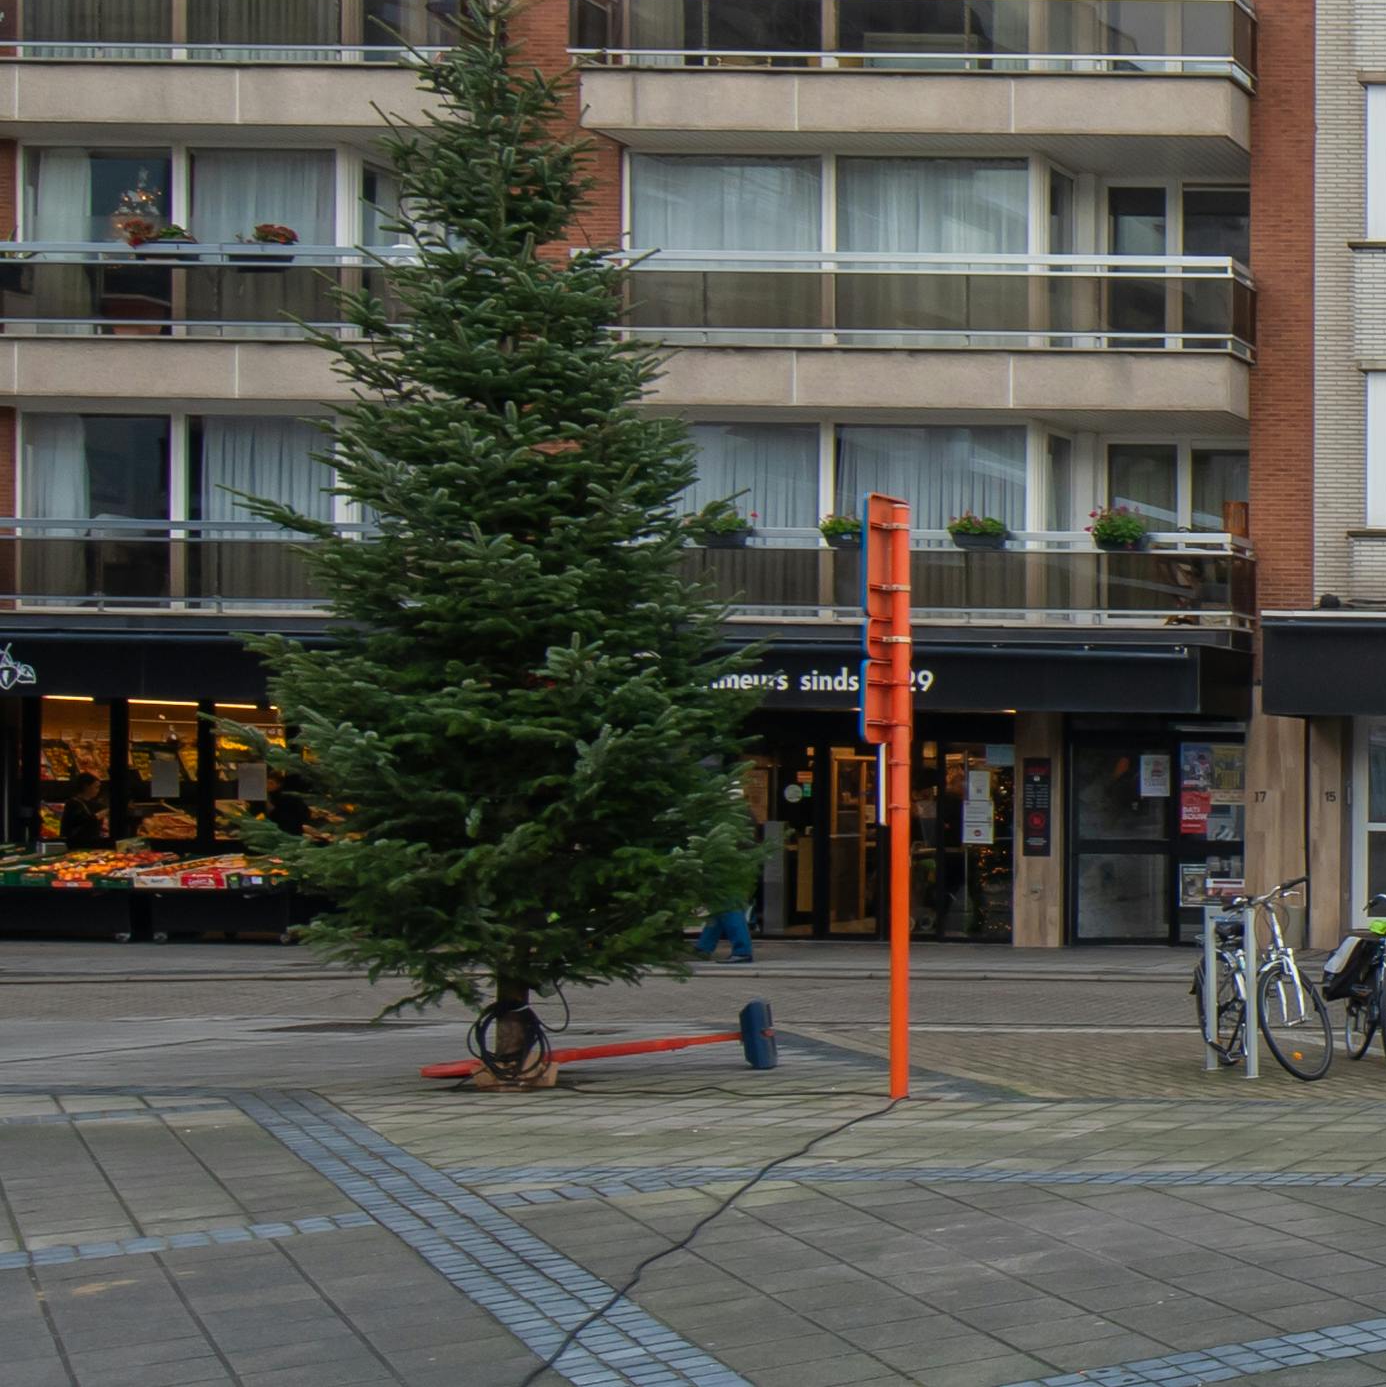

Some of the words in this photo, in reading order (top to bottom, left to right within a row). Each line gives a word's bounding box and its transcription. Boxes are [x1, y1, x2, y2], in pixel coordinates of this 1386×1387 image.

[800, 667, 860, 691] sinds
[1254, 790, 1267, 803] 17
[1325, 790, 1337, 803] 15
